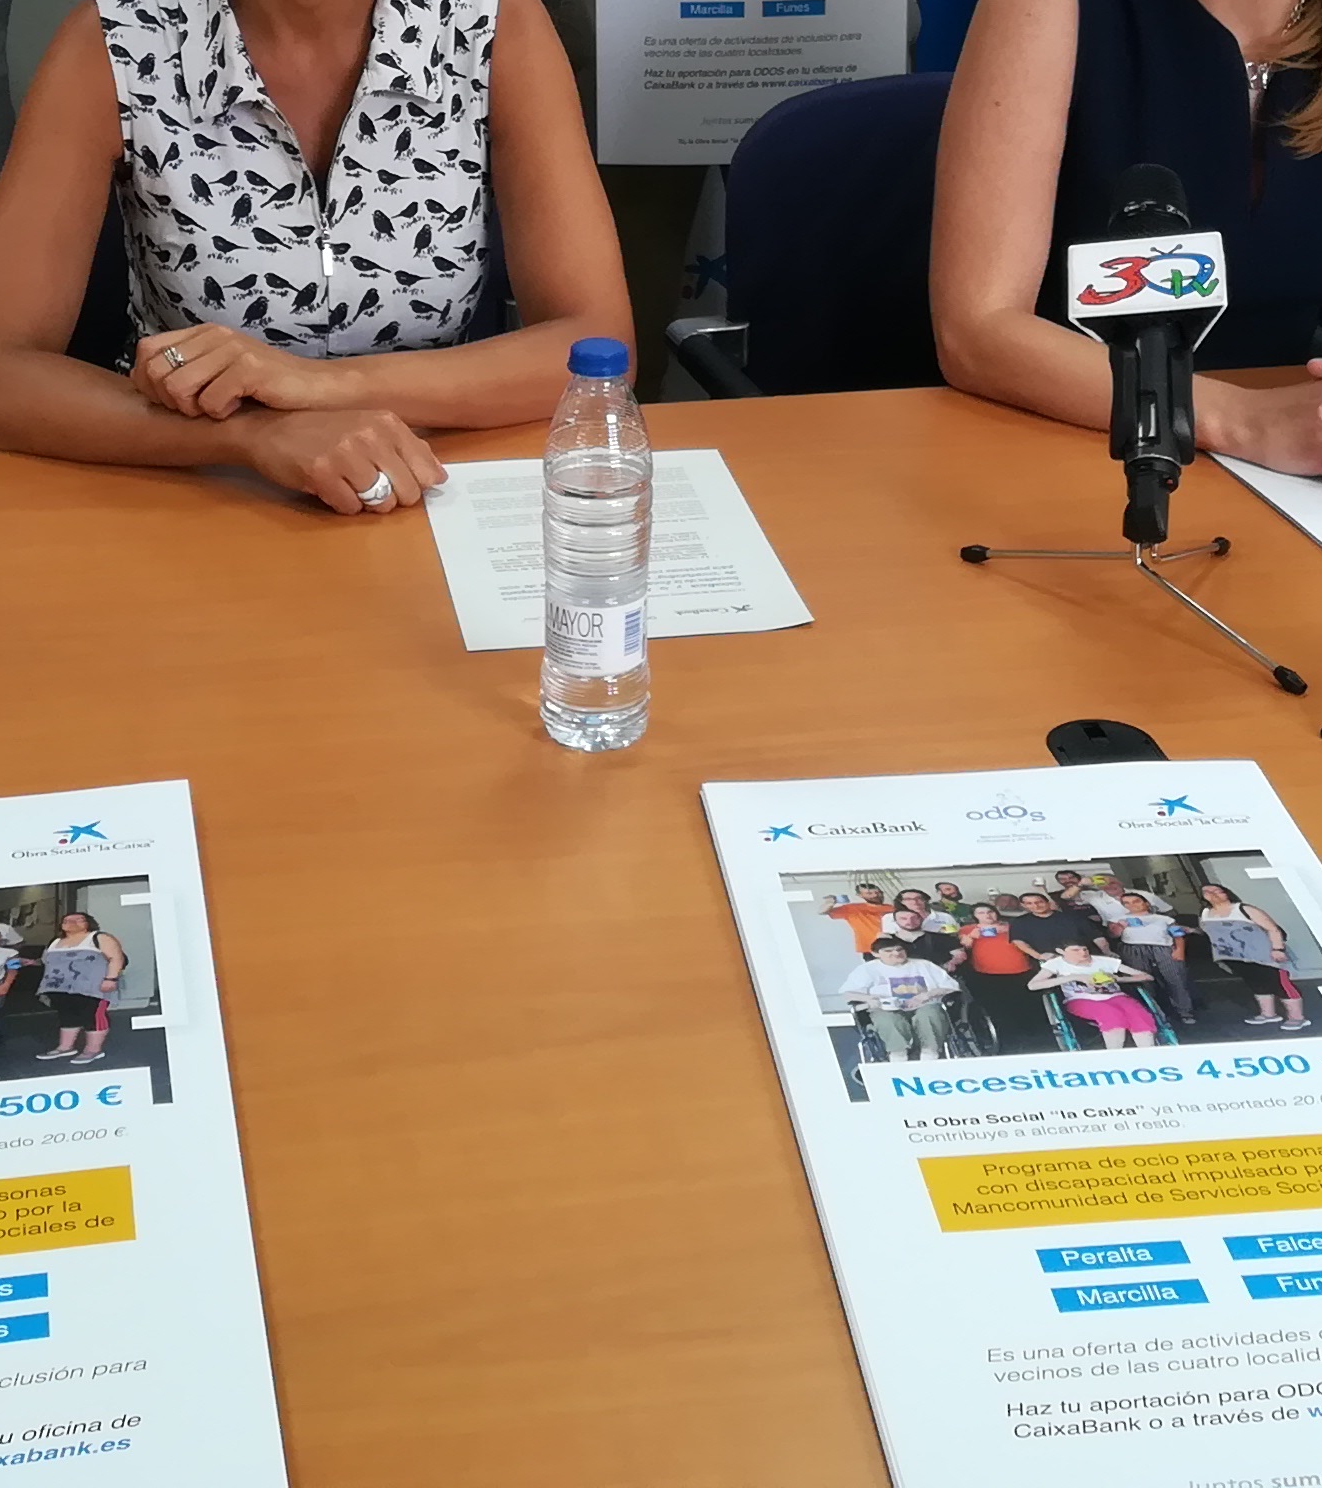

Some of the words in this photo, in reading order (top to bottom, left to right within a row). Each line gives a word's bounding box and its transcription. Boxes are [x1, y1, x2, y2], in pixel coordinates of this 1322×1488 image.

[691, 4, 732, 14] Marcilla
[777, 2, 810, 13] Funes
[806, 819, 926, 836] CaixaBank
[1118, 820, 1153, 829] Obra
[1154, 819, 1193, 828] Social
[890, 1065, 1184, 1098] Necesitamos
[1195, 1053, 1311, 1079] 4.500
[95, 1084, 123, 1106] €
[902, 1118, 928, 1129] La
[932, 1115, 981, 1127] Obra
[984, 1110, 1045, 1124] Social
[1049, 1109, 1078, 1120] "la
[1082, 1104, 1144, 1118] Caixa"
[1149, 1104, 1174, 1117] ya
[1175, 1102, 1202, 1113] ha
[1205, 1096, 1288, 1113] aportado
[907, 1129, 1009, 1144] Contribuye
[1013, 1128, 1026, 1137] a
[1030, 1122, 1107, 1136] alcanzar
[1113, 1119, 1131, 1131] el
[1134, 1118, 1185, 1130] resto.
[982, 1160, 1092, 1176] Programa
[1097, 1156, 1126, 1169] de
[1132, 1153, 1179, 1167] ocio
[1185, 1151, 1237, 1166] para
[976, 1182, 1018, 1195] con
[1025, 1170, 1177, 1192] discapacidad
[1181, 1163, 1298, 1183] impulsado
[15, 1204, 54, 1221] por
[62, 1200, 81, 1213] la
[951, 1191, 1128, 1215] Mancomunidad
[1135, 1190, 1164, 1204] de
[1168, 1183, 1272, 1202] Servicios
[84, 1214, 115, 1228] de
[1059, 1245, 1154, 1267] Peralta
[1075, 1283, 1180, 1306] Marcilla
[986, 1347, 1015, 1363] Es
[1022, 1346, 1065, 1360] una
[1071, 1340, 1137, 1357] oferta
[1144, 1336, 1174, 1352] de
[1180, 1328, 1312, 1350] actividades
[993, 1365, 1083, 1383] vecinos
[1090, 1361, 1120, 1377] de
[1127, 1358, 1160, 1374] las
[1166, 1354, 1240, 1371] cuatro
[1006, 1401, 1051, 1418] Haz
[1059, 1400, 1081, 1414] tu
[1089, 1390, 1211, 1415] aportación
[1217, 1388, 1270, 1406] para
[1013, 1416, 1142, 1439] CaixaBank
[1148, 1417, 1163, 1430] o
[1170, 1416, 1185, 1428] a
[1192, 1408, 1264, 1427] través
[1270, 1405, 1300, 1421] de
